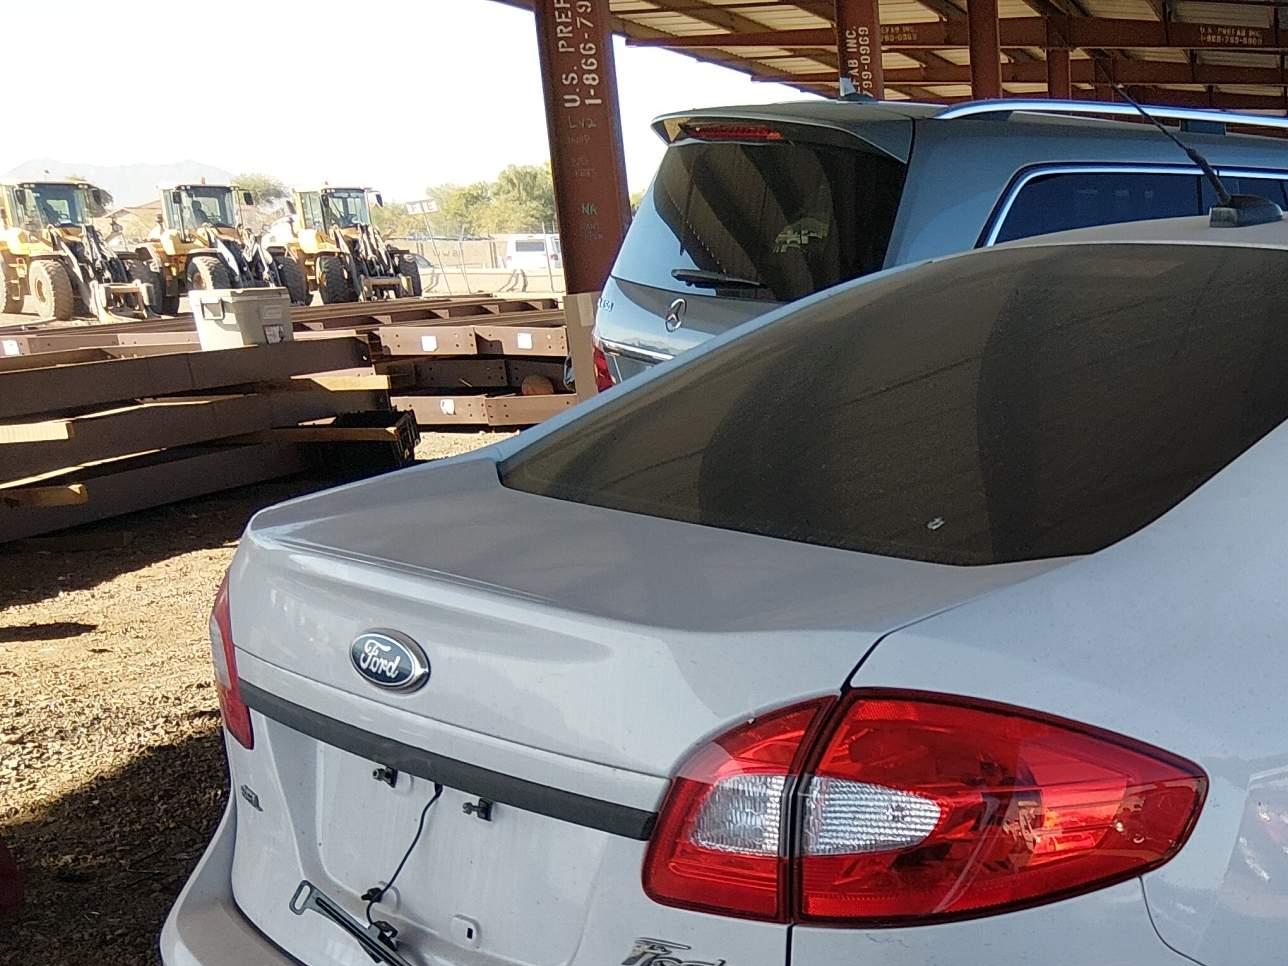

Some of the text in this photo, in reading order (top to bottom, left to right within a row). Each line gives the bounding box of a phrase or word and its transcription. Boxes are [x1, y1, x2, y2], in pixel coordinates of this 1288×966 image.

[845, 26, 858, 52] INC.
[562, 66, 581, 108] U.S.
[360, 639, 401, 679] Ford
